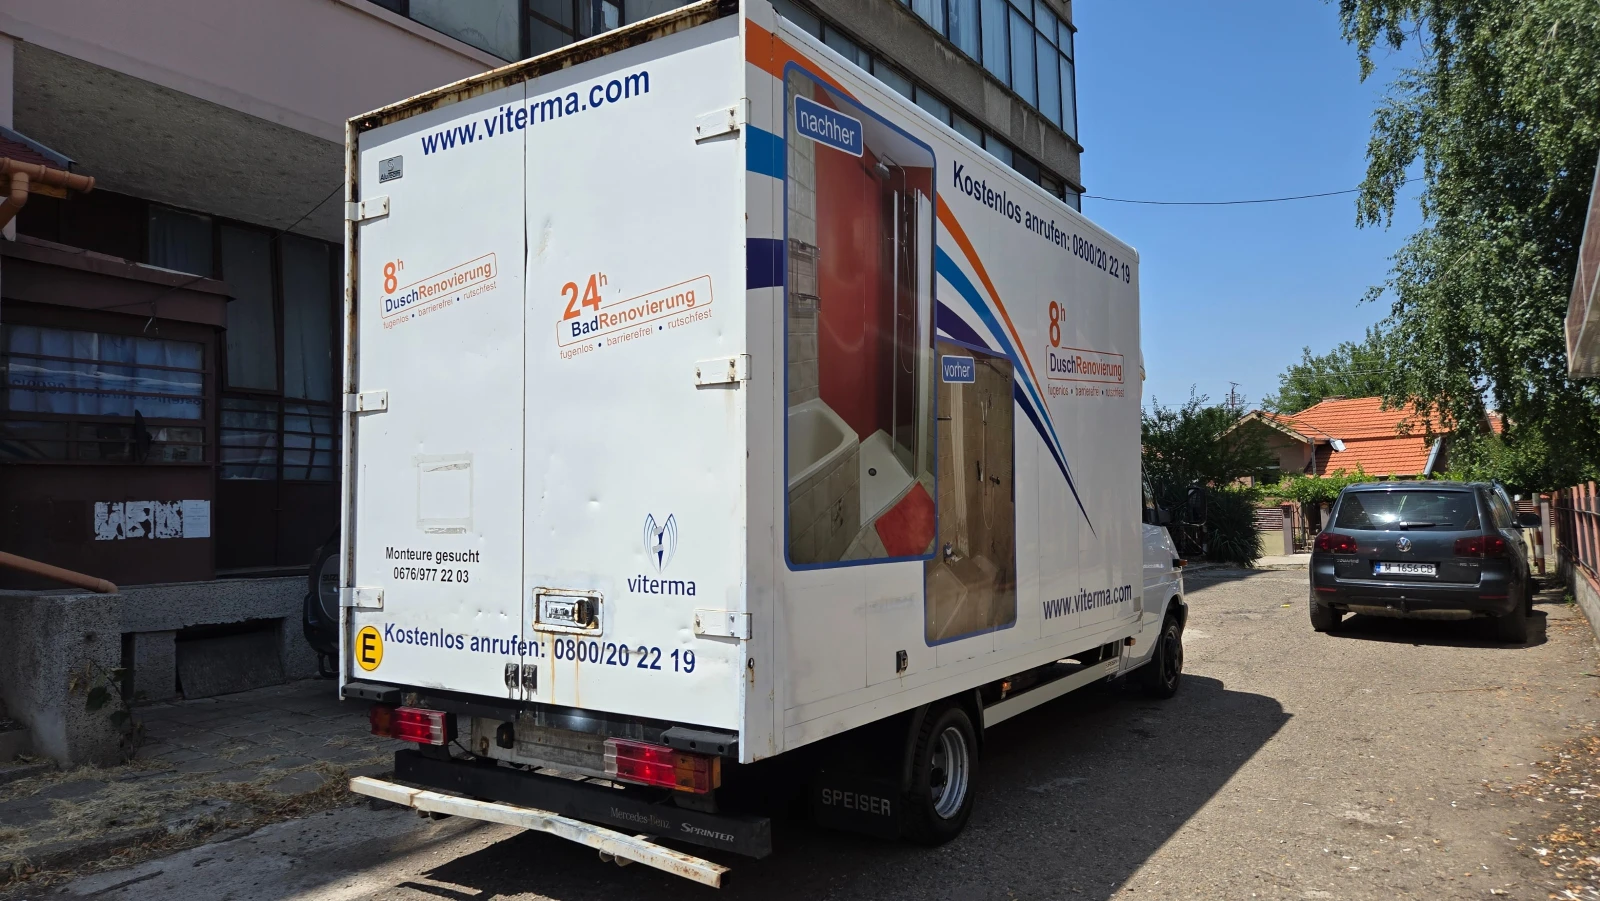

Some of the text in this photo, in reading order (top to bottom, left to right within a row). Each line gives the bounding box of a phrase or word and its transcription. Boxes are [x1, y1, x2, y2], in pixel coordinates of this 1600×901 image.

[421, 70, 650, 155] www.viterma.com
[800, 110, 855, 146] nachher
[953, 160, 1131, 284] Kostenlos anrufen: 0800/20 22 19
[385, 262, 492, 313] DuschRenovierung
[383, 281, 497, 330] fugenlos barrierefrei rutschfest
[571, 290, 695, 337] BadRenovierung
[560, 308, 713, 359] fugenlos barrierefrei rutschfest
[944, 361, 970, 378] vorher
[1049, 352, 1122, 381] DuschRenovierung
[385, 546, 480, 564] Monteure gesucht
[1397, 563, 1419, 573] 1656
[393, 566, 469, 583] 0676/977 22 03
[627, 574, 696, 596] viterma
[1043, 584, 1132, 620] www.viterma.com
[361, 633, 376, 664] E
[384, 622, 696, 674] Kostenlos anrufen: 0800/20 22 19
[821, 787, 891, 817] SPEISER
[610, 806, 671, 830] Mercedes-Benz
[680, 822, 735, 843] SPRINTER
